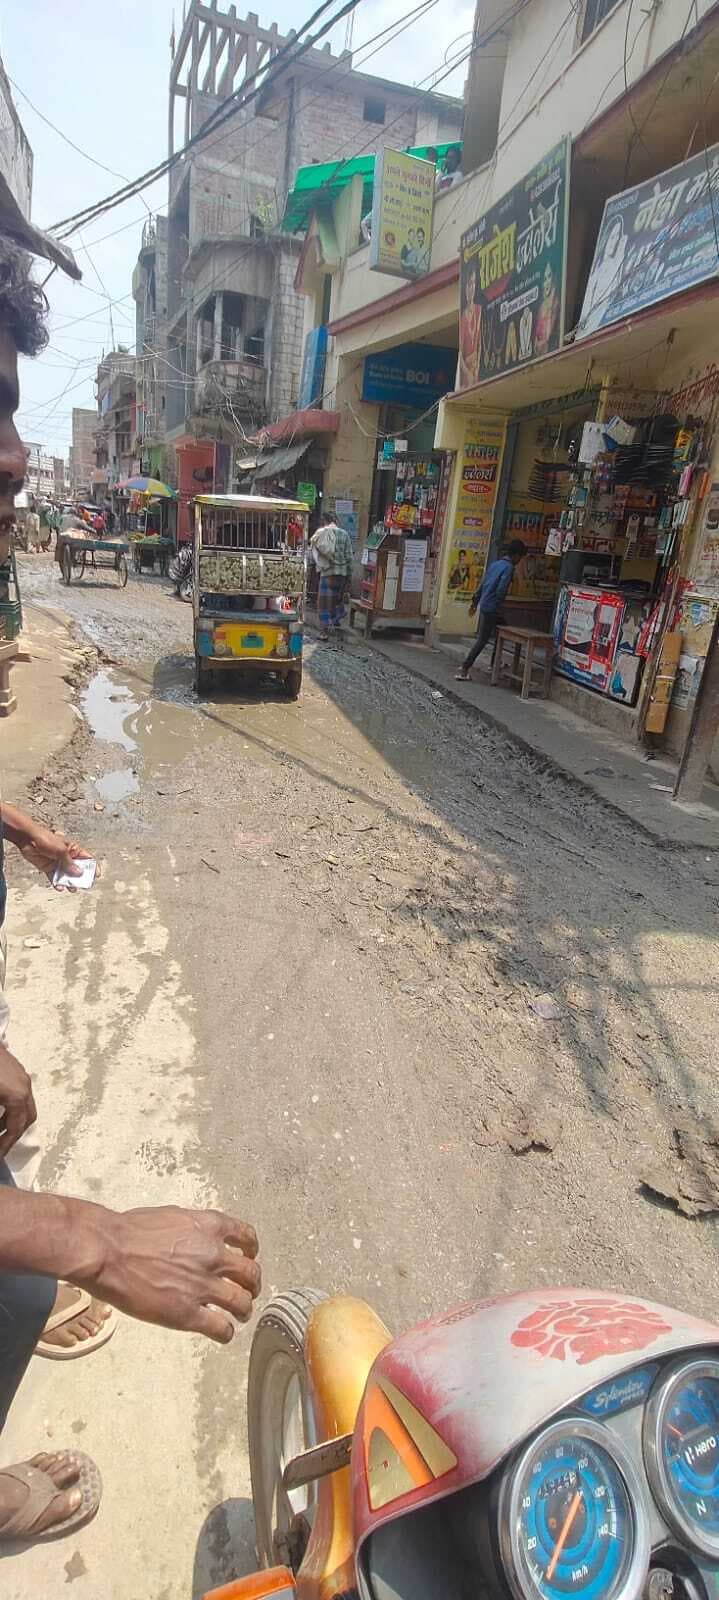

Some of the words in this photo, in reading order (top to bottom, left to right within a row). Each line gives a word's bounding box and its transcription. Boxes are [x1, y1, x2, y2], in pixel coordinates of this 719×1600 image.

[633, 181, 692, 234] नेहा
[479, 221, 517, 290] राजेश
[516, 178, 562, 275] ज्वेलर्स
[406, 369, 431, 385] BOI
[593, 1380, 645, 1408] Splendor
[695, 1436, 717, 1457] Hero
[577, 1458, 588, 1472] 100
[522, 1496, 531, 1508] 40
[696, 1499, 707, 1516] N
[597, 1524, 609, 1538] 140
[527, 1537, 537, 1551] 20
[571, 1564, 588, 1583] km/h
